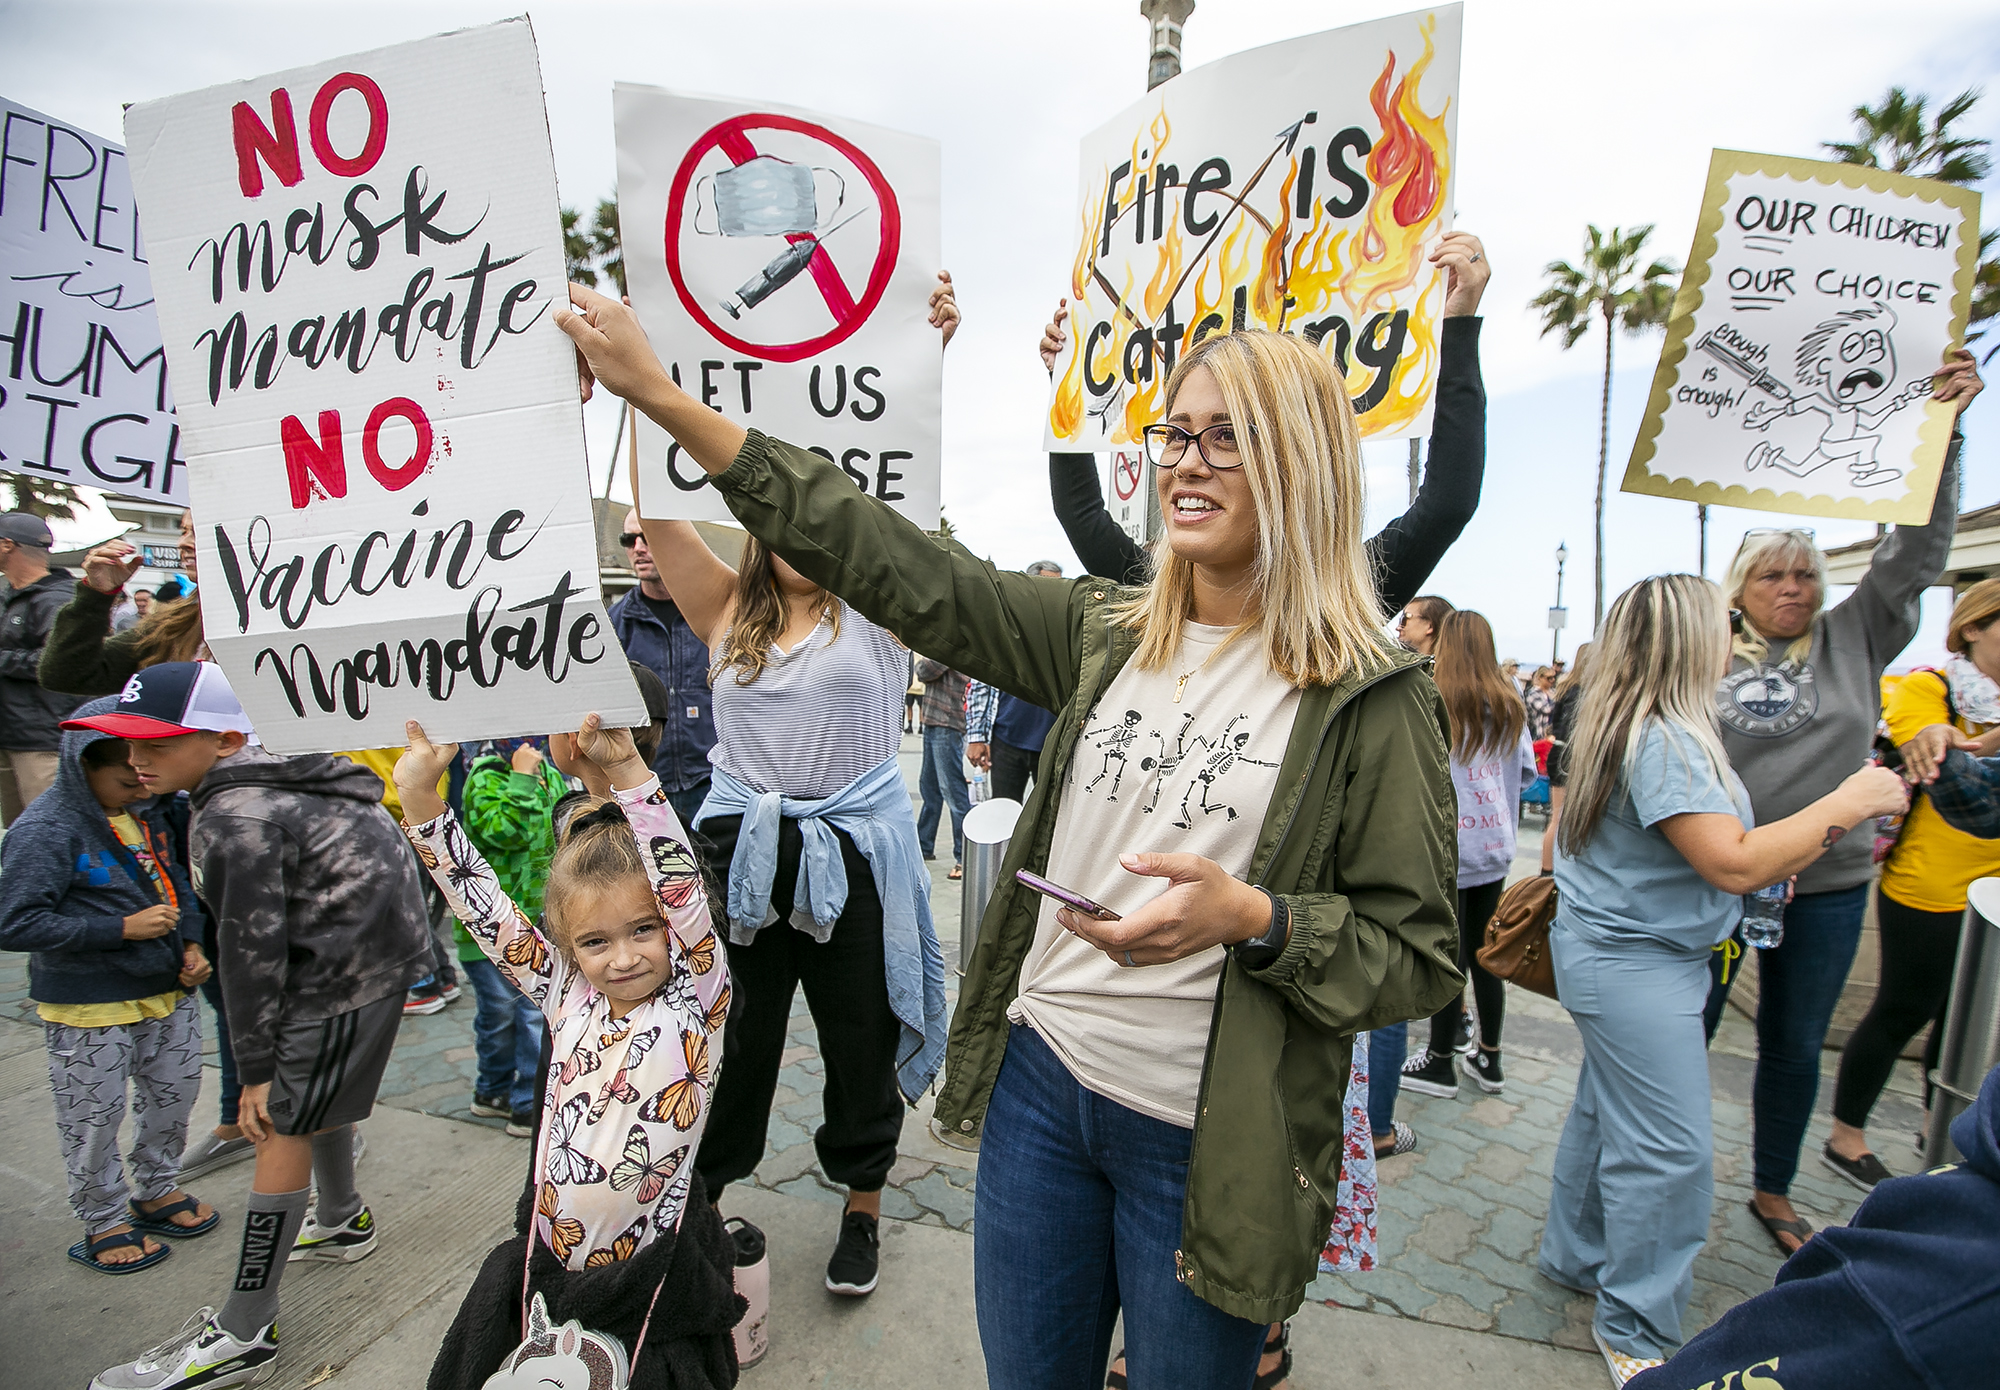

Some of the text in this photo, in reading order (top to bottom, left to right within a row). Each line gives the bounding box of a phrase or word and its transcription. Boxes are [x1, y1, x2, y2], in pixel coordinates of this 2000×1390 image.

[232, 72, 389, 200] NO
[0, 110, 149, 264] FRE
[1101, 110, 1372, 258] Fire is
[1736, 196, 1952, 249] OUR CHILDREN
[188, 165, 491, 304] mask
[10, 259, 156, 311] is
[1728, 267, 1942, 304] OUR CHOICE
[0, 301, 177, 414] HUM
[1714, 323, 1770, 363] enough
[0, 383, 188, 495] IGH
[809, 364, 887, 421] US
[1678, 385, 1747, 418] enough!
[280, 397, 435, 509] NO
[214, 496, 563, 634] Vaccine
[1468, 762, 1502, 782] LOVE
[238, 1214, 278, 1289] STANCE
